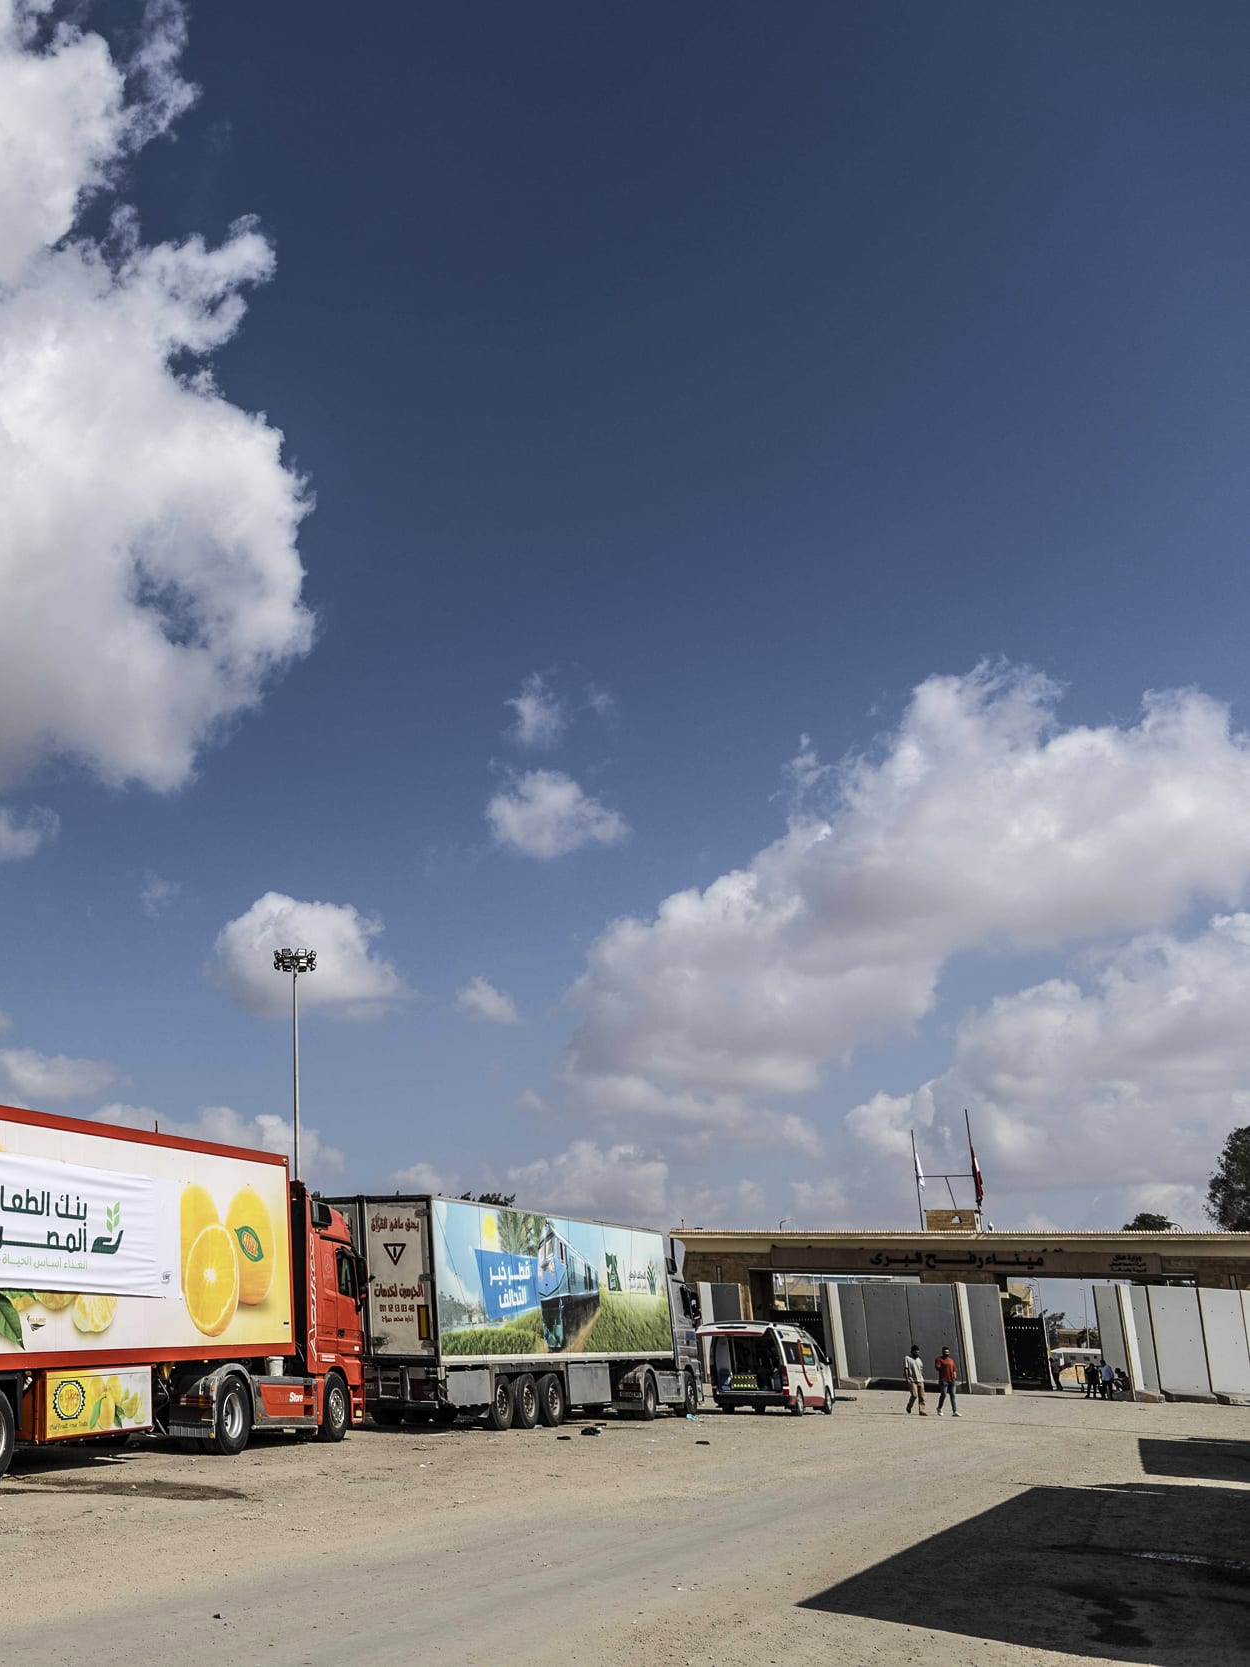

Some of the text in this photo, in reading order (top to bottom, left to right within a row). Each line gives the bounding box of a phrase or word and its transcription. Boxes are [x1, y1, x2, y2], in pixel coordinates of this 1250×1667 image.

[54, 1194, 88, 1221] بنك
[925, 1251, 984, 1269] رفح
[985, 1253, 1045, 1270] ميناء
[398, 1282, 424, 1300] الحرمين
[499, 1285, 527, 1309] التحالف
